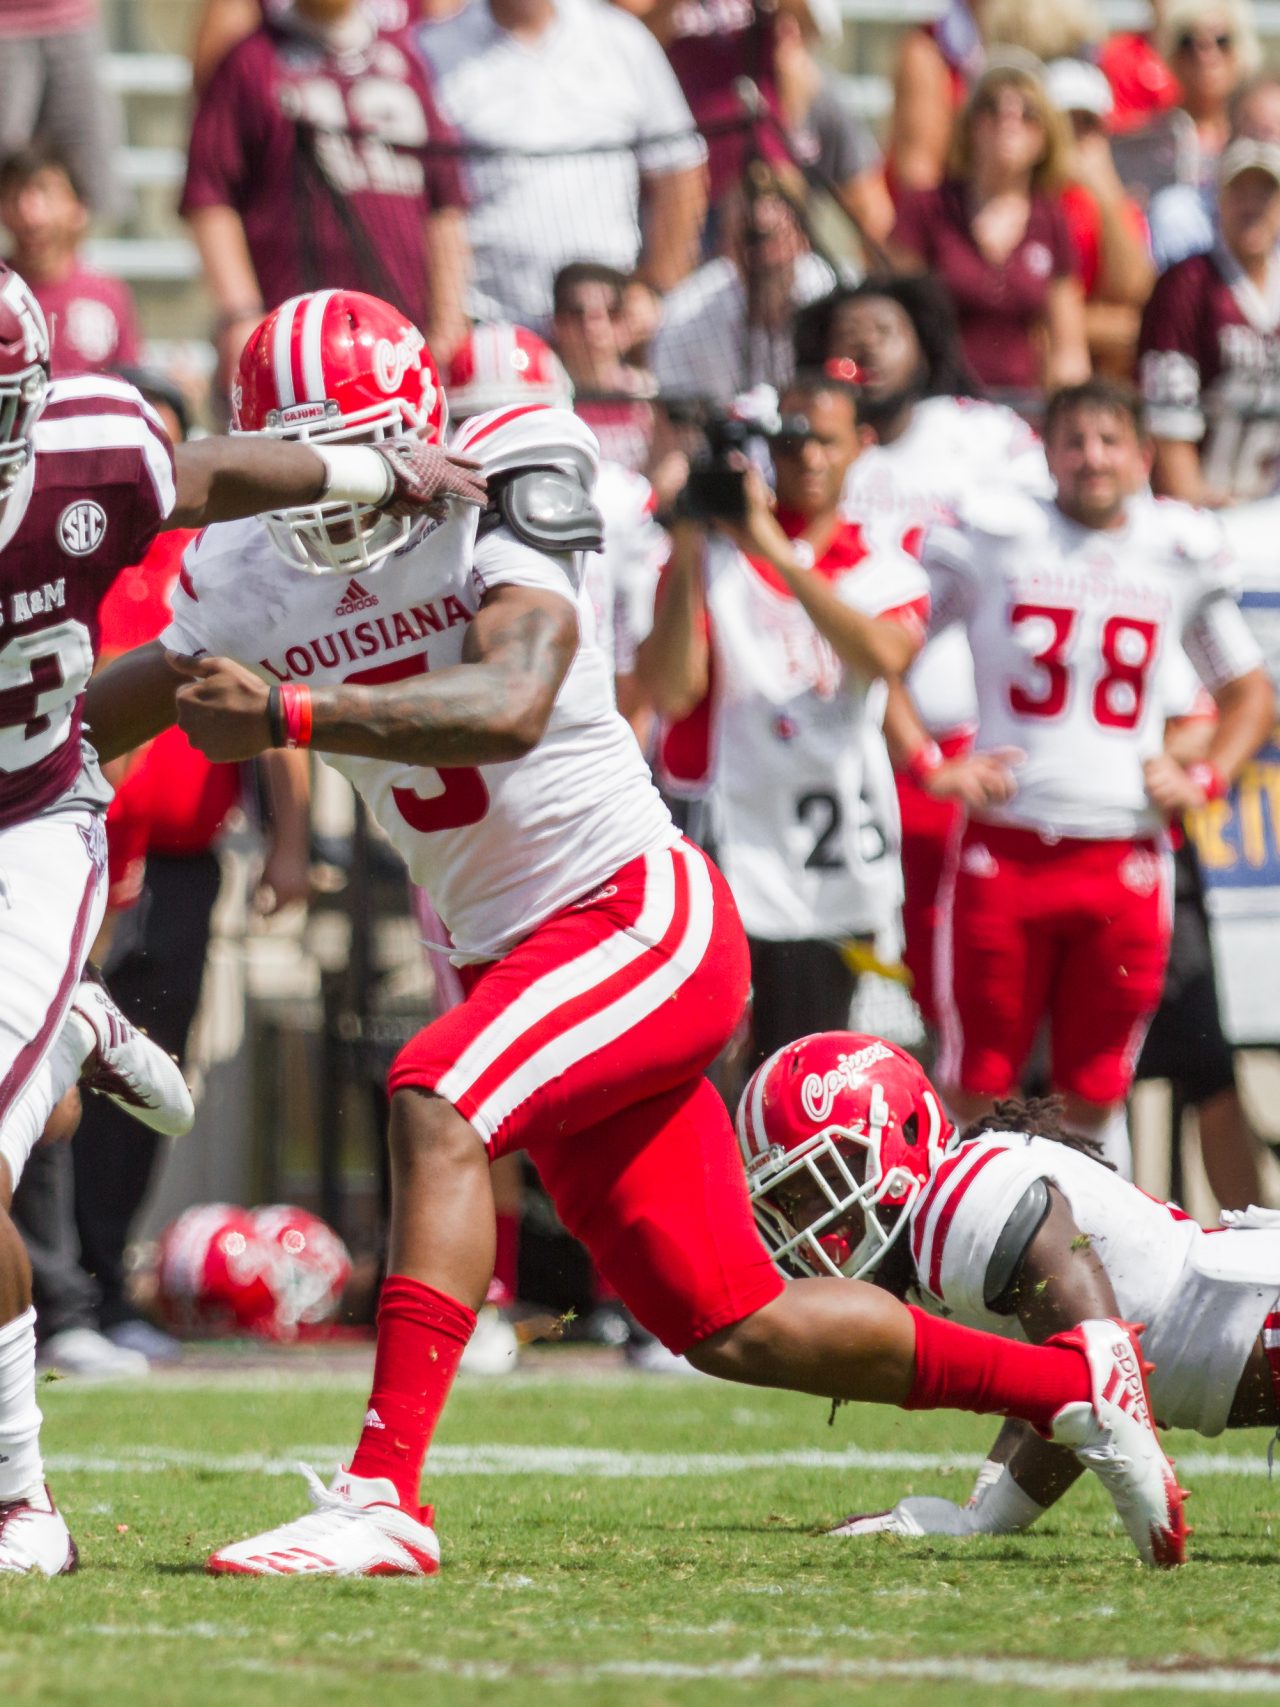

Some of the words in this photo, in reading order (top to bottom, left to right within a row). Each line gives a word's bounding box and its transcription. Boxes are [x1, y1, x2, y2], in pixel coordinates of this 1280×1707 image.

[283, 406, 323, 423] CAJUNS
[61, 504, 104, 550] SEC
[12, 577, 67, 624] A&M
[335, 594, 380, 617] adidas
[259, 593, 475, 682] LOUISIANA
[1008, 602, 1158, 731] 38
[800, 1040, 895, 1123] Cajuns
